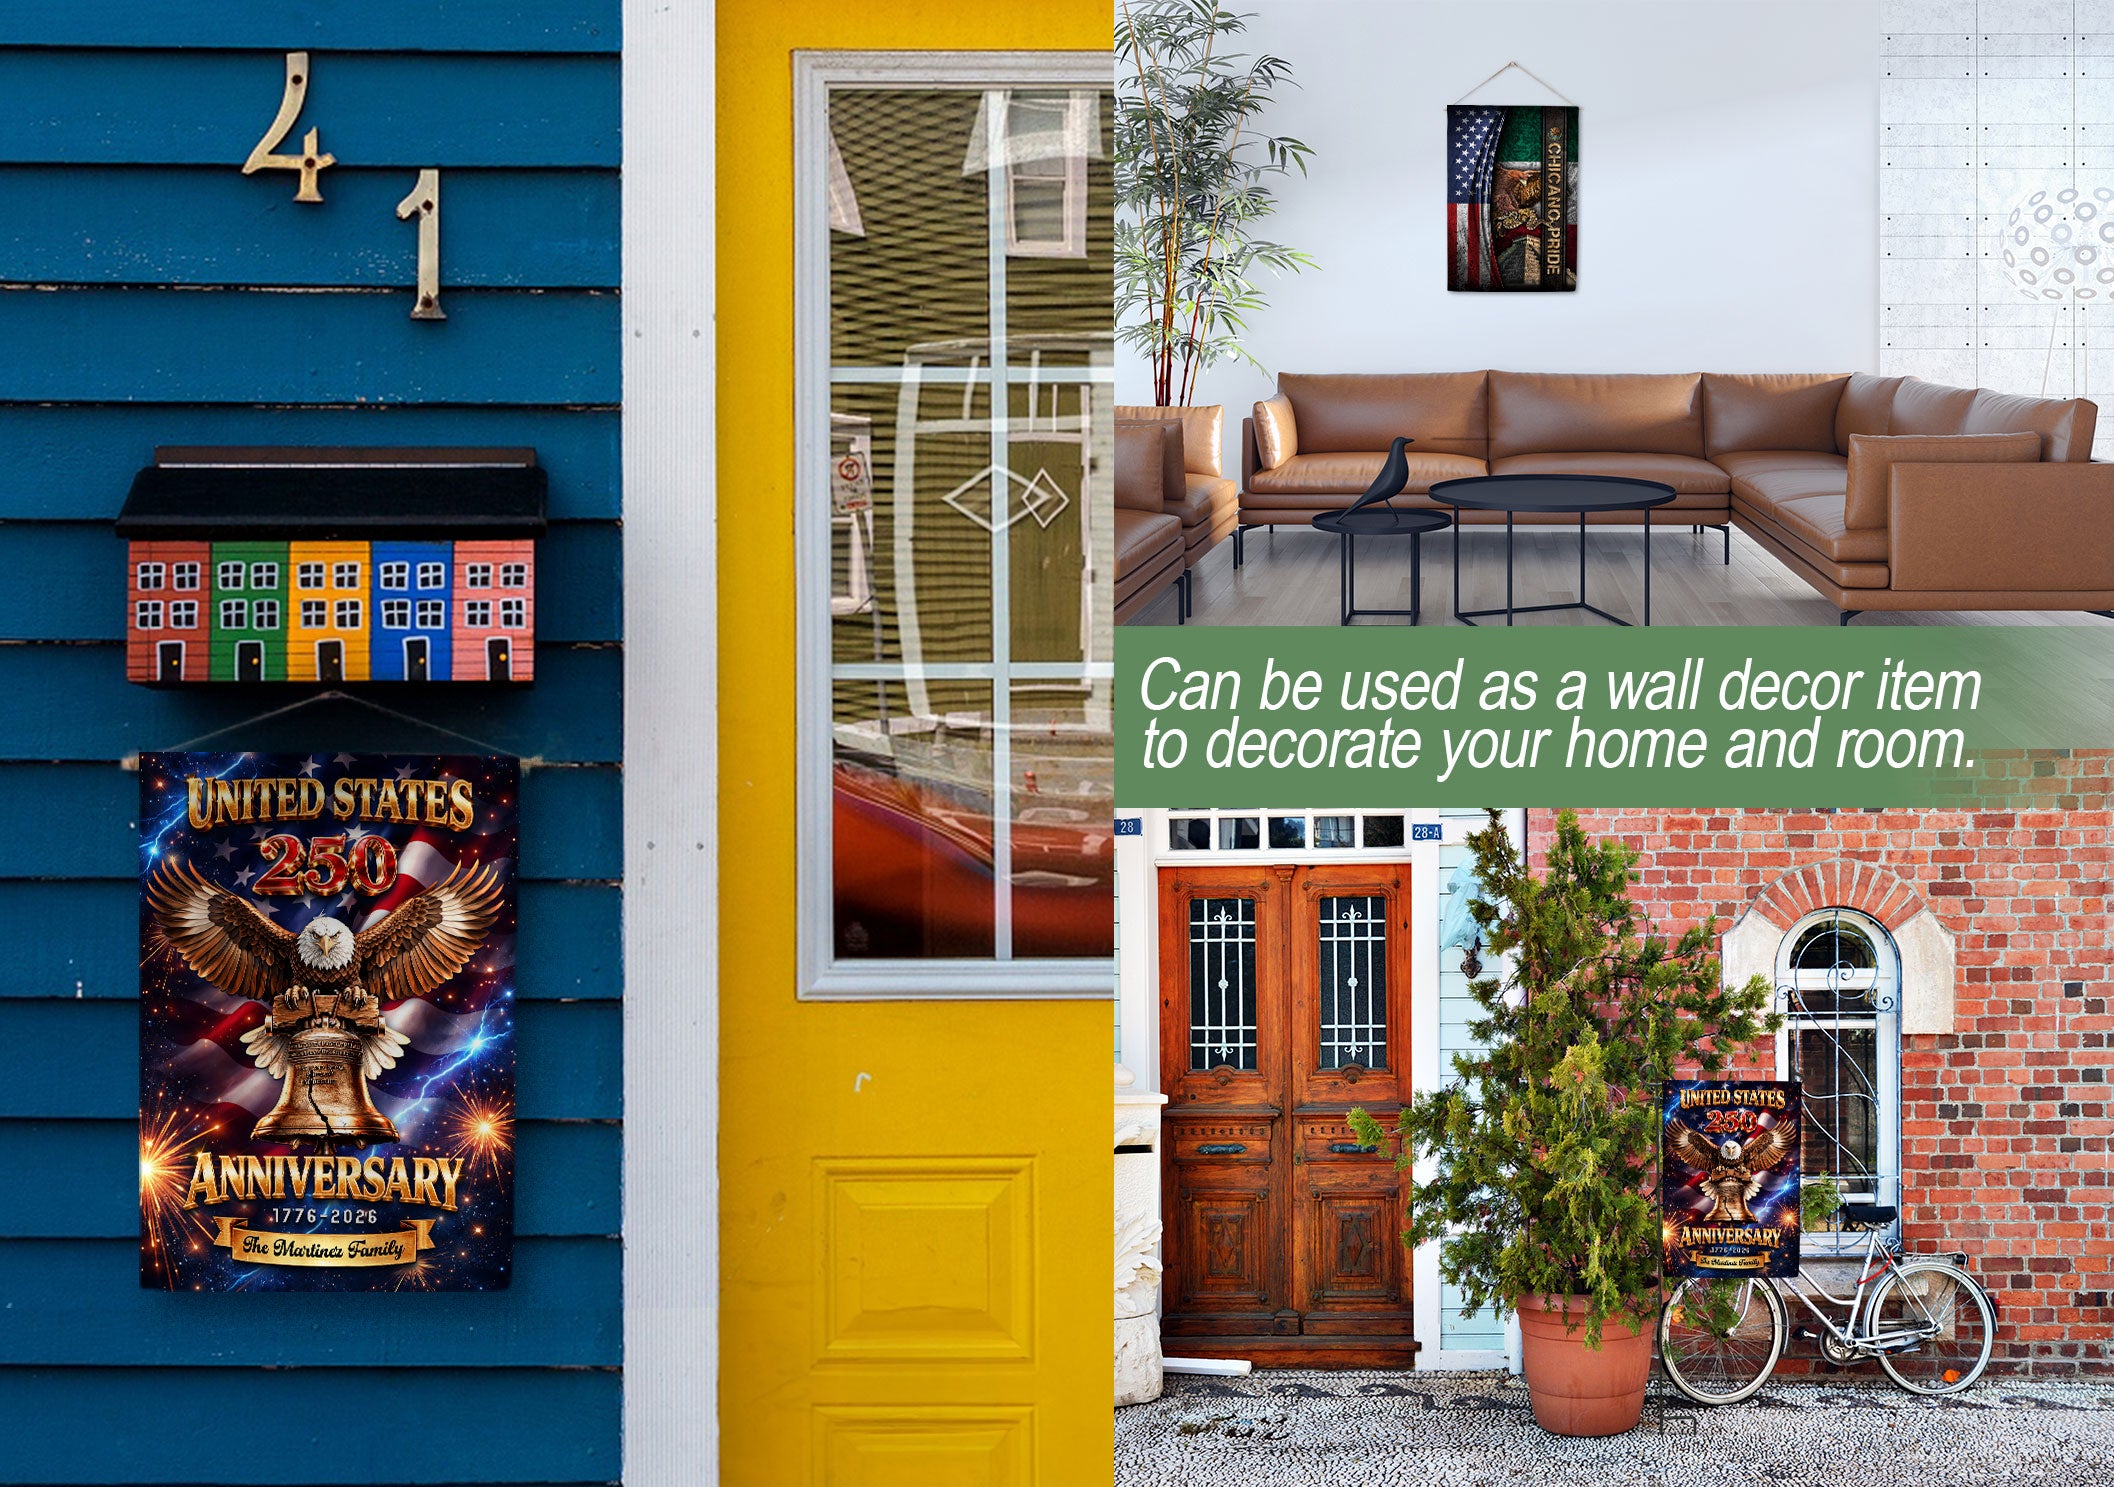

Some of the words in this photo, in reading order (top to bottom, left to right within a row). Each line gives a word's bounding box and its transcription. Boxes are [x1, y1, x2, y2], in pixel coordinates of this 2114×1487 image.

[1547, 142, 1562, 221] CHICANO
[1546, 226, 1561, 275] PRIDE
[186, 774, 326, 830] UNITED
[332, 777, 475, 832] STATES
[1120, 821, 1134, 833] 28
[1414, 826, 1440, 839] 28-A
[252, 833, 400, 898] 250
[1680, 1089, 1731, 1109] UNITED
[1733, 1089, 1786, 1109] STATES
[1703, 1110, 1759, 1134] 250
[183, 1150, 465, 1212] ANNIVERSARY
[272, 1207, 378, 1225] 1776-2026
[242, 1235, 269, 1254] The
[273, 1238, 344, 1259] Martinez
[349, 1239, 404, 1261] Family
[1678, 1225, 1782, 1249] ANNIVERSARY
